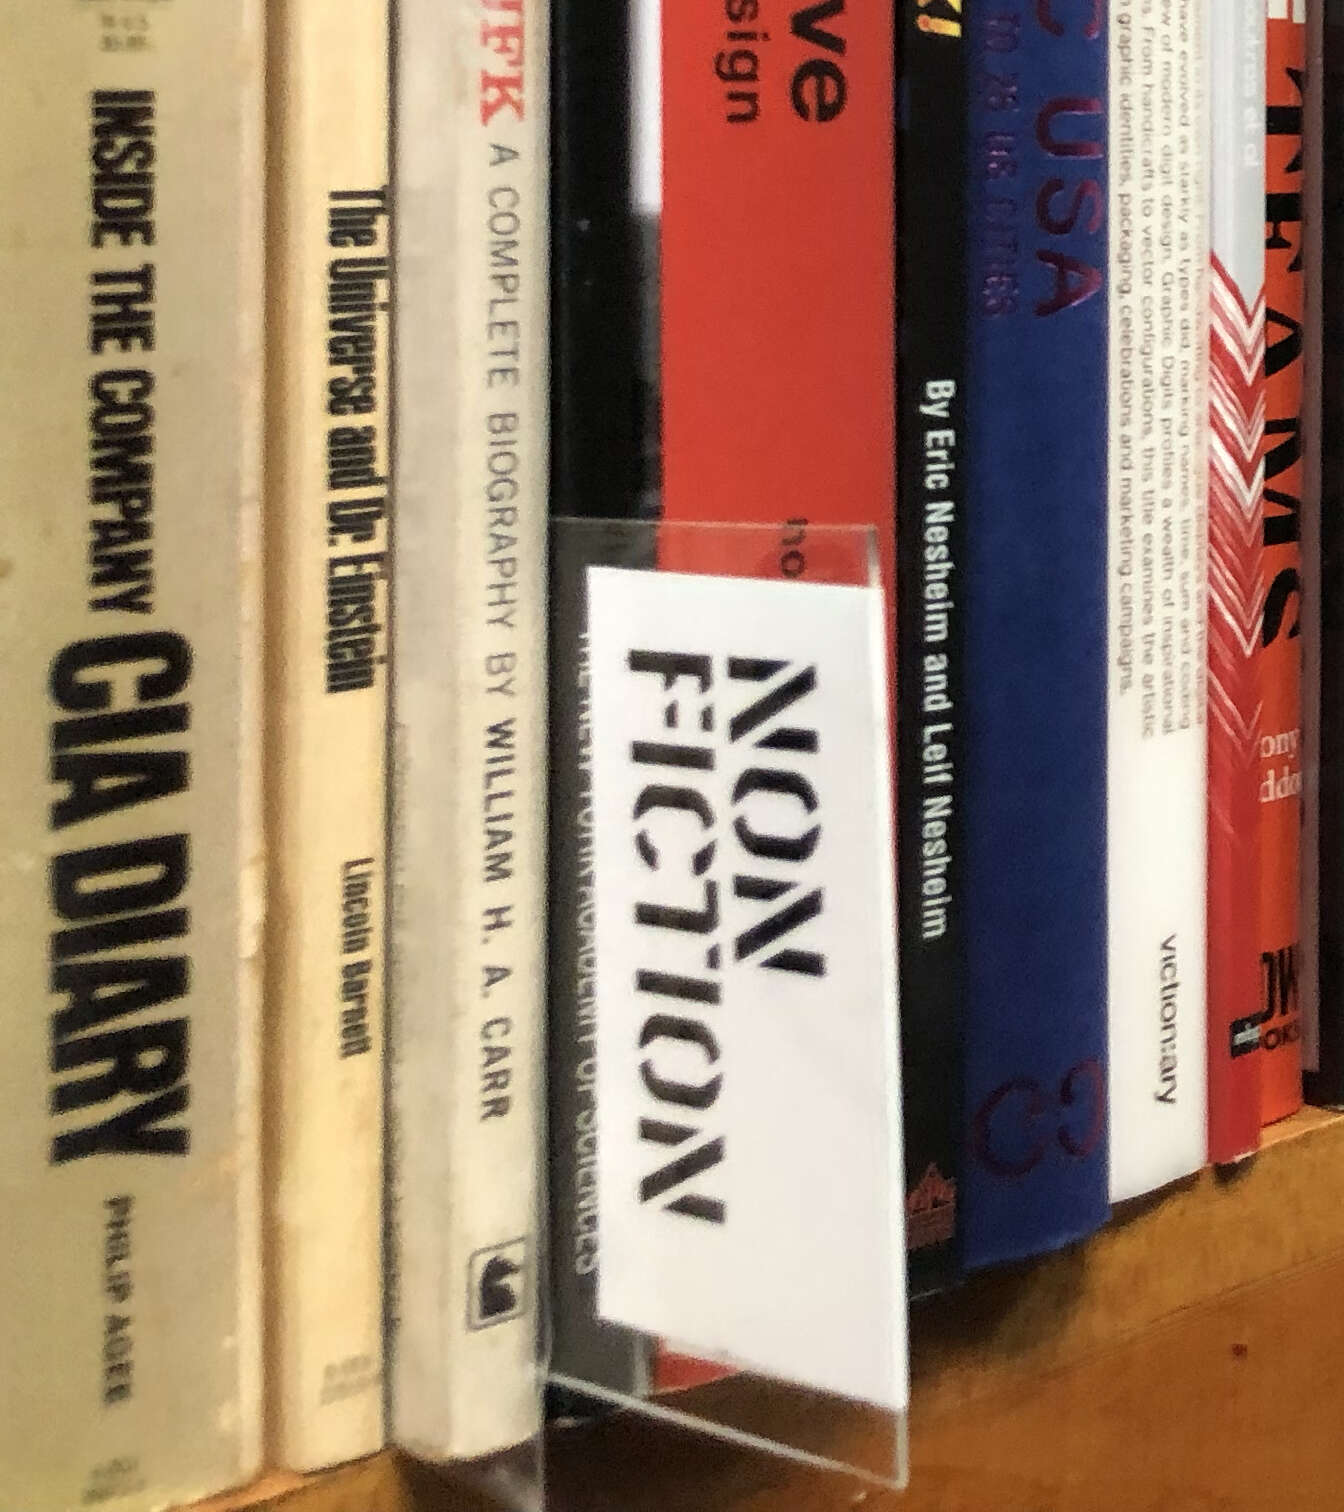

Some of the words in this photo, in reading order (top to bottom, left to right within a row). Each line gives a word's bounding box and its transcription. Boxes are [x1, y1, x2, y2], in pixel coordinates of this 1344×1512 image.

[90, 88, 155, 246] INSIDE
[328, 187, 389, 248] The
[487, 142, 520, 169] A
[1033, 95, 1107, 320] USA
[90, 264, 155, 355] THE
[326, 257, 388, 416] Universe
[485, 187, 520, 390] COMPLETE
[326, 426, 386, 489] and
[920, 380, 956, 419] By
[922, 429, 956, 491] Eric
[88, 368, 155, 616] COMPANY
[484, 412, 519, 631] BIOGRAPHY
[326, 554, 388, 693] Einstein
[922, 501, 956, 643] Nesheim
[48, 631, 194, 831] CIA
[486, 651, 516, 697] BY
[922, 655, 954, 712] and
[484, 717, 516, 884] WILLIAM
[728, 655, 829, 978] NON
[920, 794, 954, 940] Nesheim
[341, 857, 375, 954] Lincoln
[627, 648, 729, 1225] FICTION
[48, 833, 192, 1167] DIARY
[340, 959, 373, 1060] Barnett
[480, 1016, 512, 1125] CARR
